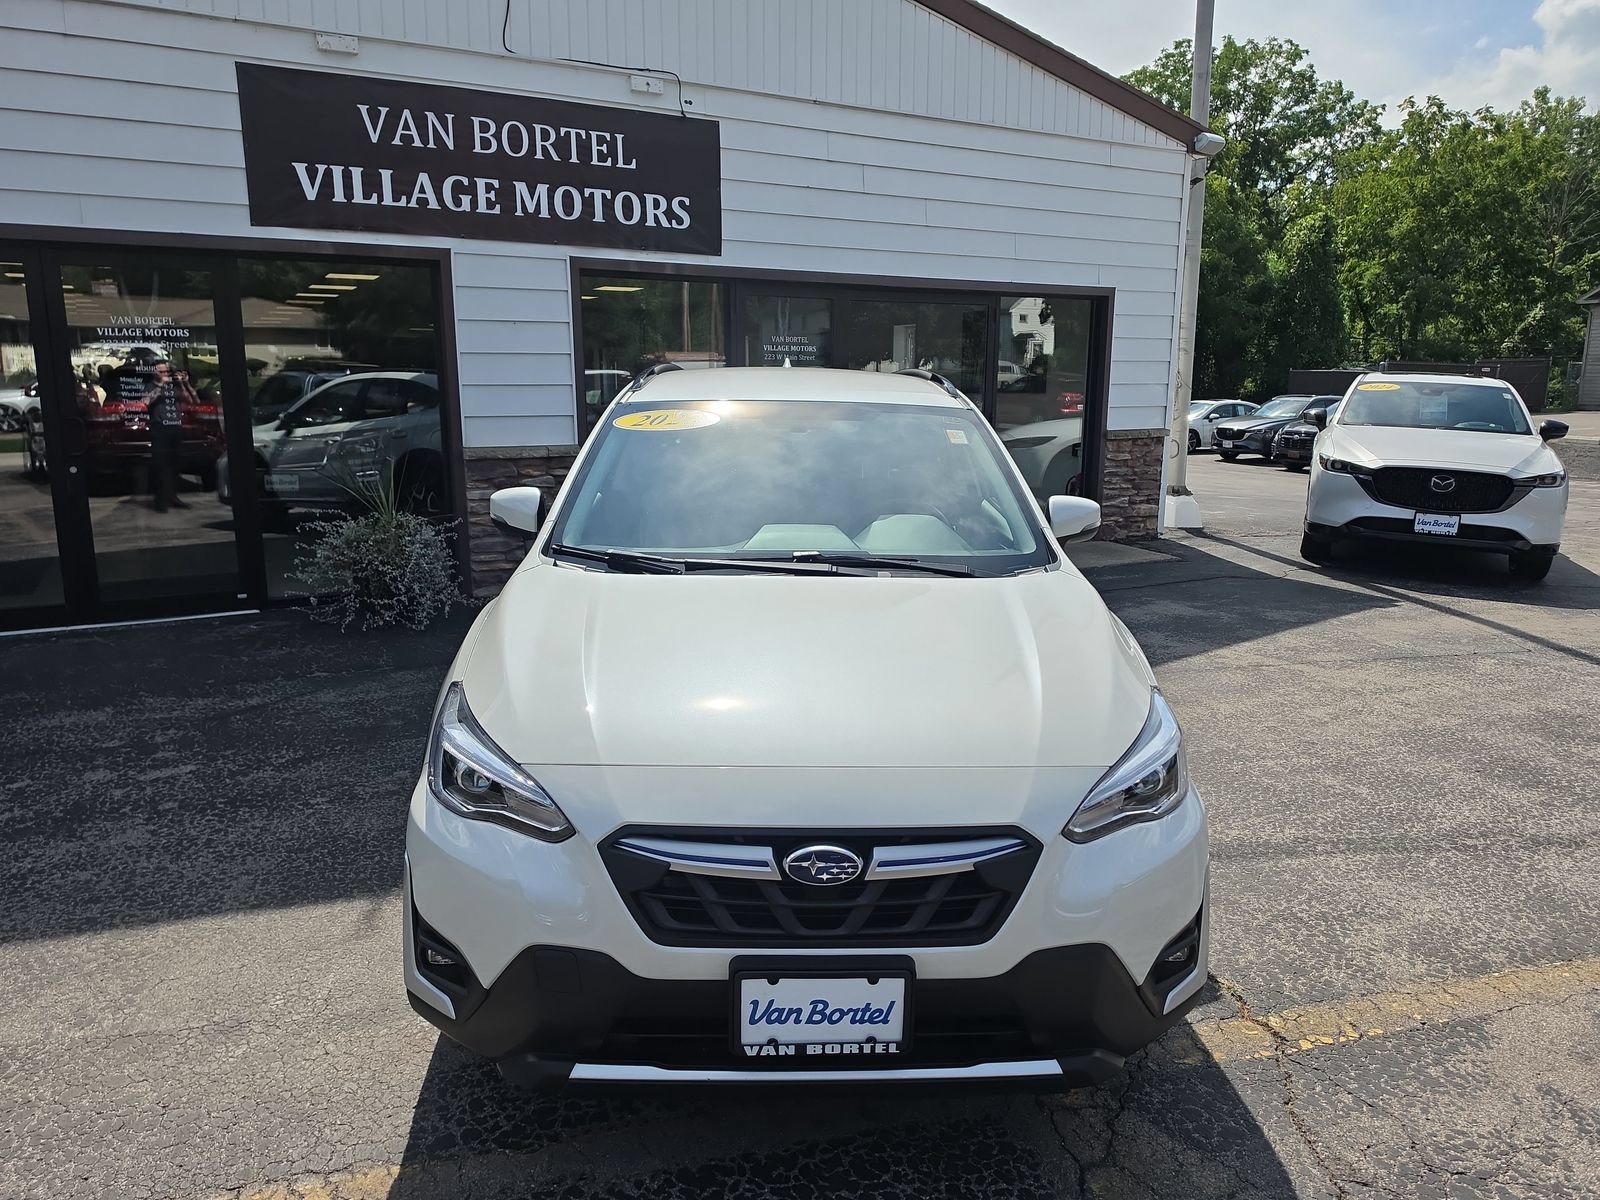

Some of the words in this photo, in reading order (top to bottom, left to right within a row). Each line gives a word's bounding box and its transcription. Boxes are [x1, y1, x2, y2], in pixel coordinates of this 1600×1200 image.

[356, 104, 455, 151] VAN
[470, 116, 637, 169] BORTEL
[291, 162, 501, 215] VILLAGE
[513, 181, 692, 230] MOTORS
[110, 316, 132, 325] VAN
[135, 317, 175, 326] BORTEL
[97, 328, 142, 337] VILLAGE
[144, 329, 190, 337] MOTORS
[160, 340, 190, 349] Street
[771, 335, 784, 343] VAN
[785, 336, 809, 344] BORTEL
[763, 344, 790, 352] VILLAGE
[791, 345, 817, 353] MOTORS
[764, 353, 776, 361] 223
[1416, 518, 1431, 526] Van
[1431, 519, 1456, 529] Bortel
[748, 998, 803, 1026] Van
[804, 999, 897, 1026] Bortel
[743, 1044, 796, 1057] VAN
[806, 1042, 900, 1056] BORTEL
